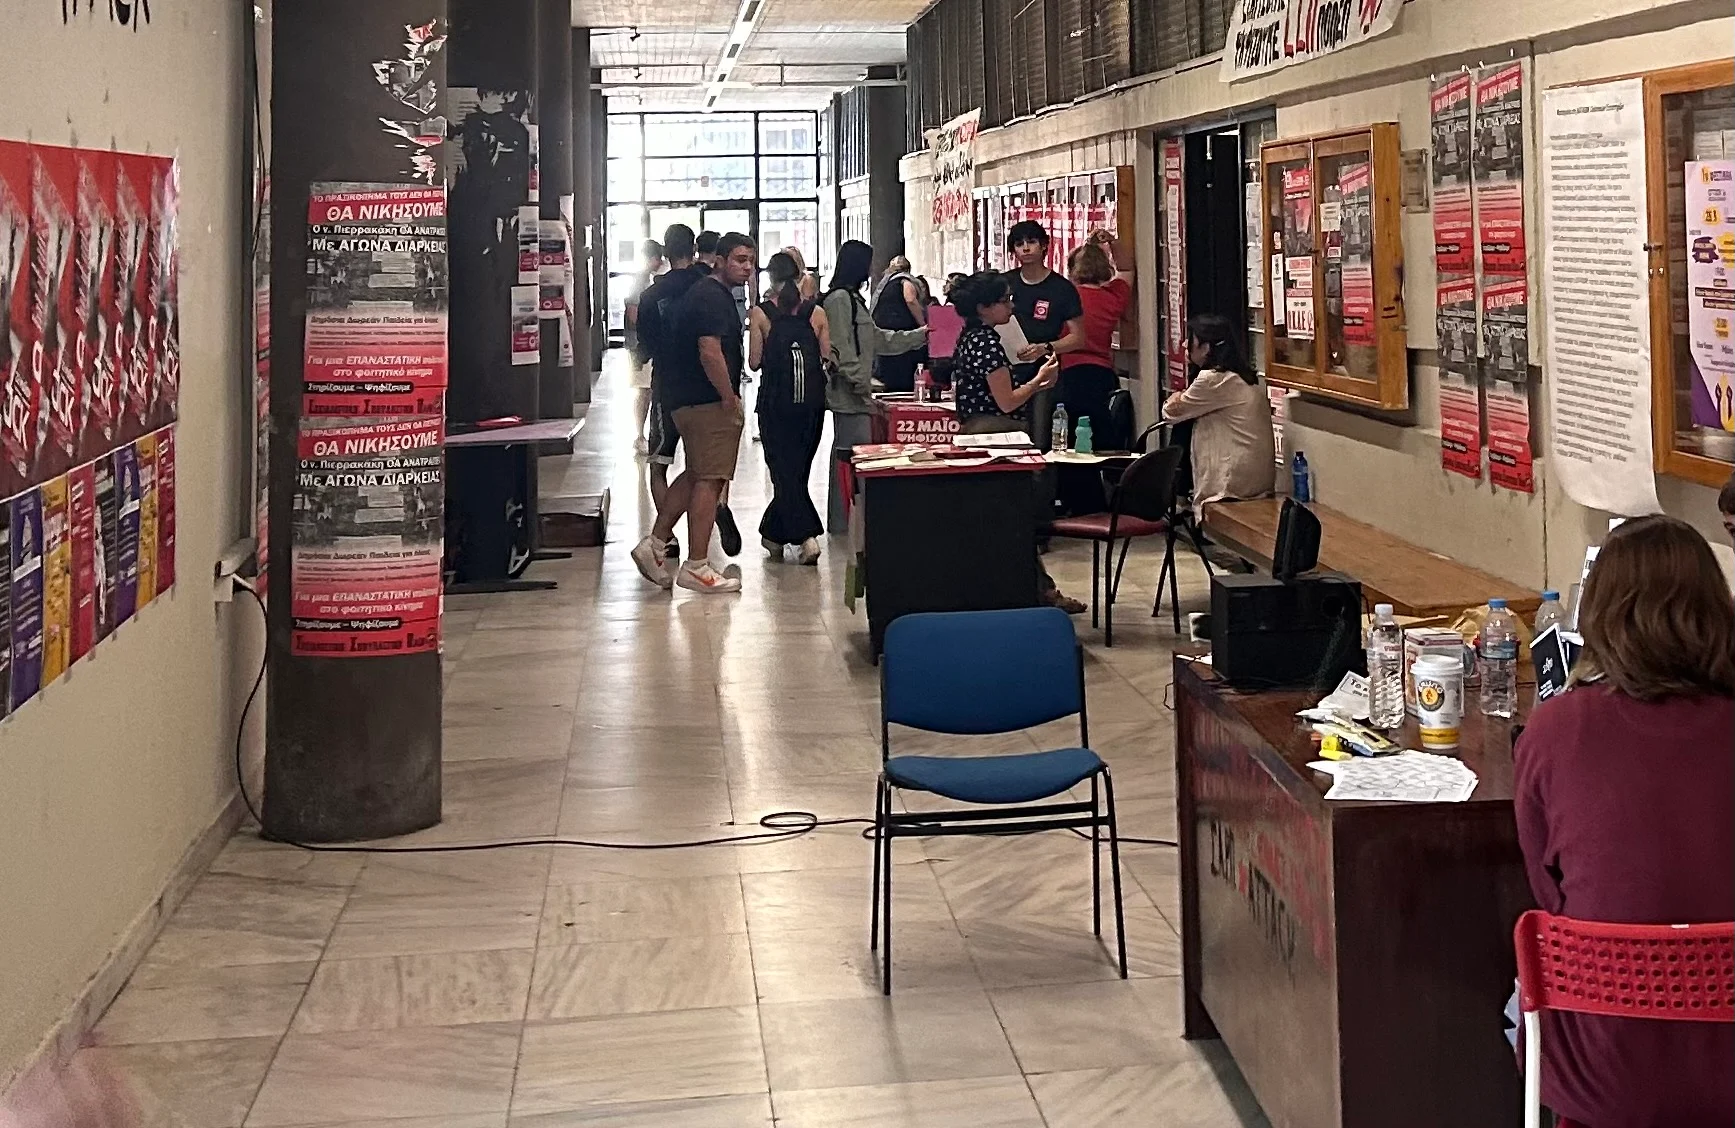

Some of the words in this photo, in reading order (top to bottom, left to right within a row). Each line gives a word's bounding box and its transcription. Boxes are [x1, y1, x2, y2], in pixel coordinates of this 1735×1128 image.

[327, 205, 354, 221] ΘΑ
[359, 201, 443, 220] ΝΙΚΗΣΟΥΜΕ
[312, 224, 320, 233] Ο
[334, 225, 397, 237] Πιερρακάκη
[312, 238, 335, 251] Με
[340, 239, 390, 251] ΑΓΩΝΑ
[346, 355, 421, 365] ΕΠΑΝΑΣΤΑΤΙΚΗ
[332, 369, 352, 377] στο
[355, 366, 404, 378] φοιτητικό
[896, 420, 915, 432] 22
[917, 416, 961, 432] ΜΑΪΟ
[314, 440, 339, 456] ΘΑ
[344, 430, 438, 454] ΝΙΚΗΣΟΥΜΕ
[896, 433, 953, 443] ΨΗΦΙΖΟΥ
[320, 459, 384, 470] Πιερρακάκη
[300, 473, 322, 487] Με
[325, 474, 378, 487] ΑΓΩΝΑ
[382, 470, 440, 486] ΔΙΑΡΚΕΙΑΣ
